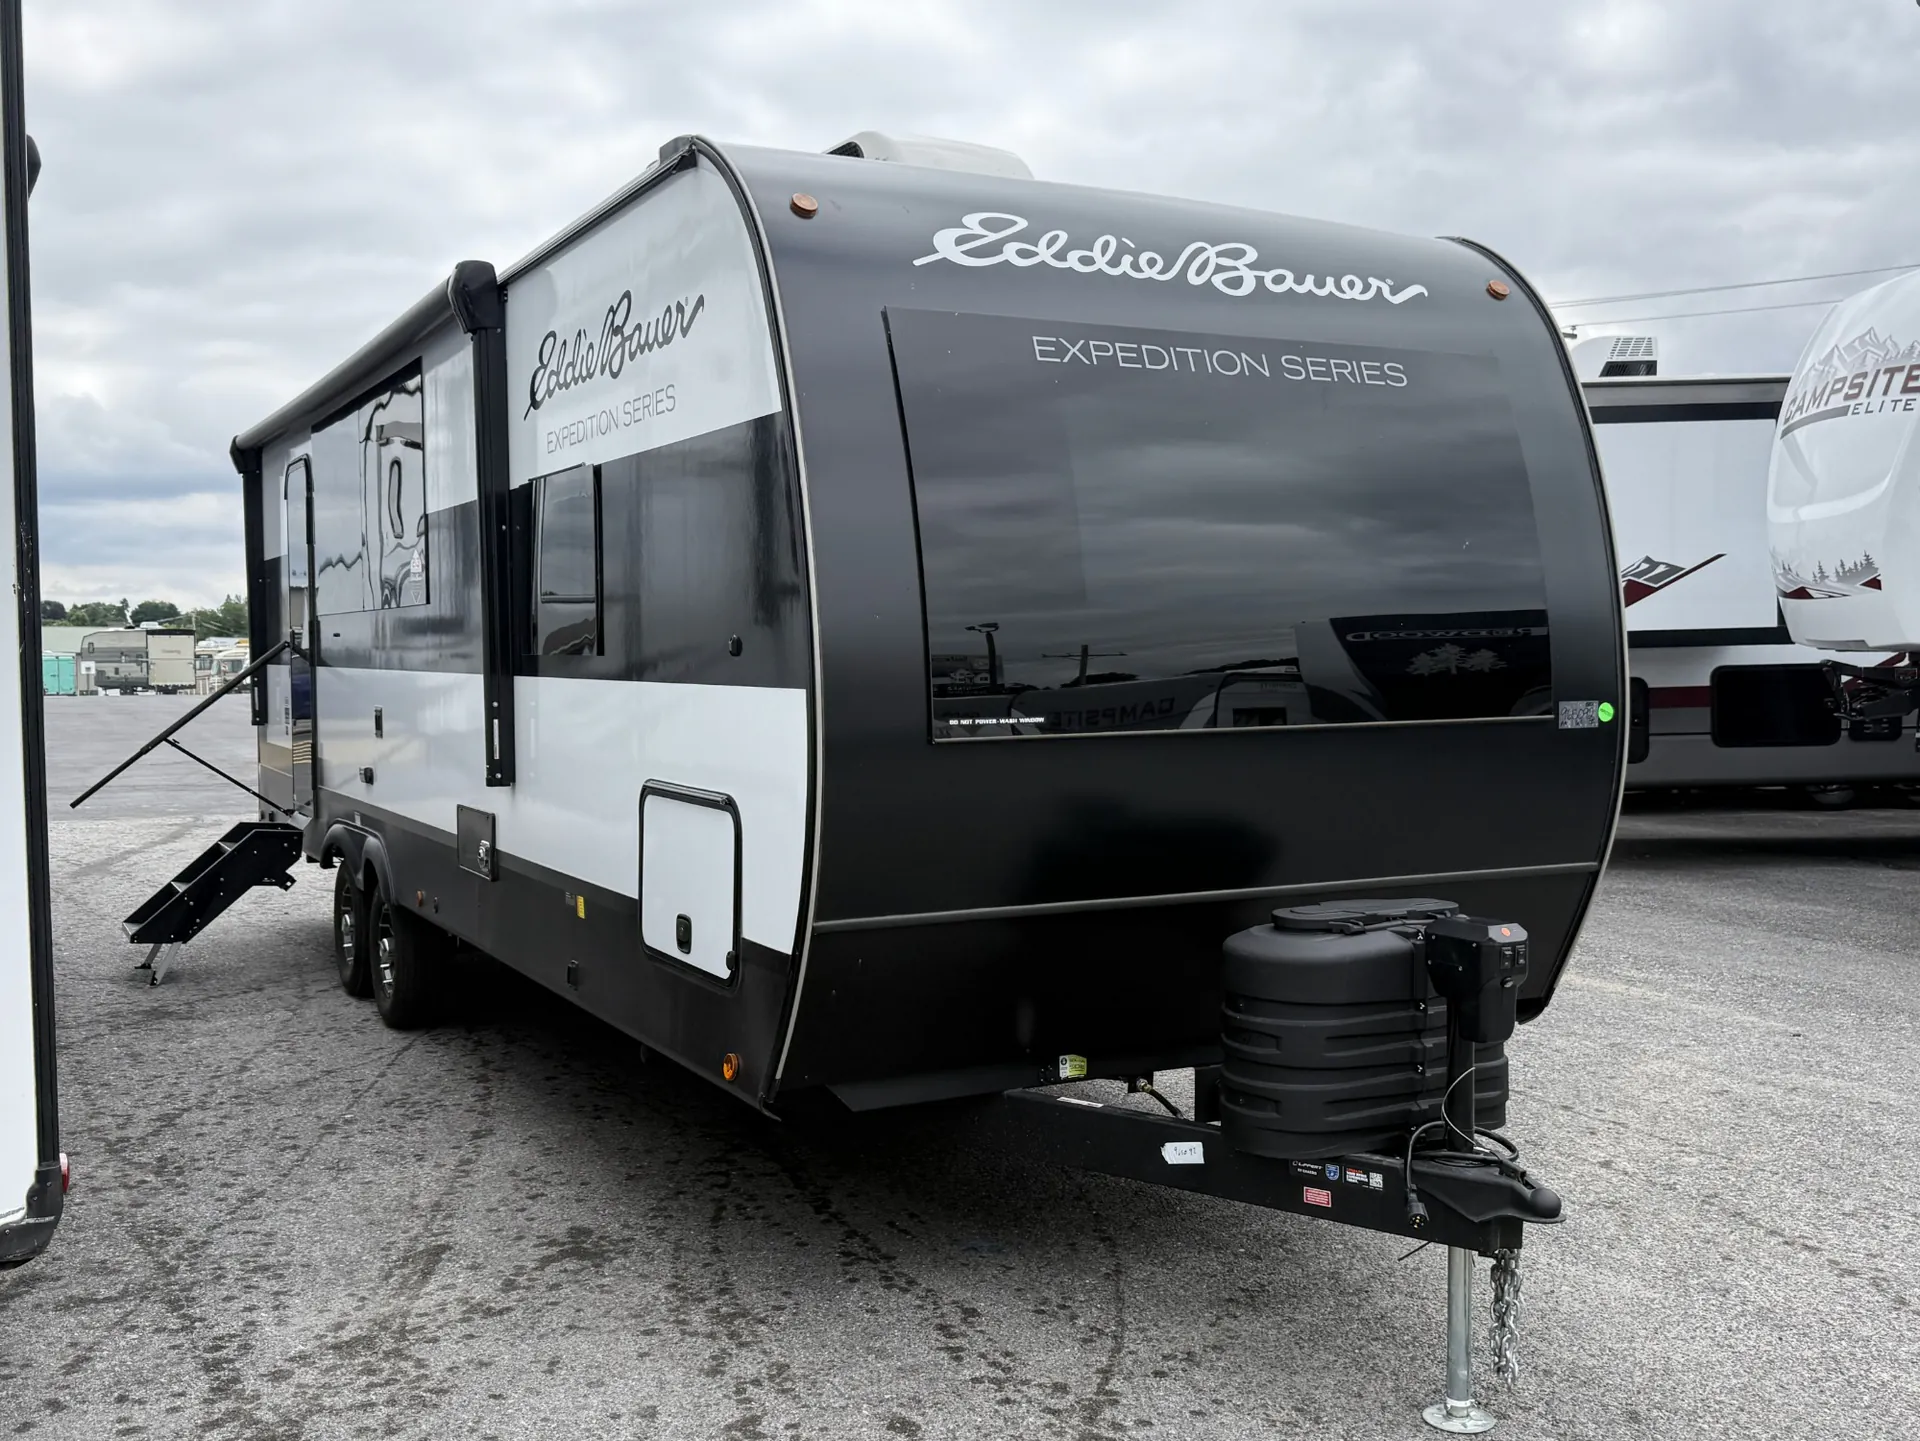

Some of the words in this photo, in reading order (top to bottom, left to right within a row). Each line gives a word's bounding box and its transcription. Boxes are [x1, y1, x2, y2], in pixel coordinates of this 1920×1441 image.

[912, 212, 1172, 280] Eddie
[1172, 241, 1429, 304] Bauer
[523, 330, 600, 421] Eddie
[599, 289, 705, 380] Bauer
[1032, 335, 1270, 378] EXPEDITION
[1281, 354, 1408, 387] SERIES
[546, 405, 619, 454] EXPEDITION
[622, 383, 676, 427] SERIES
[1783, 363, 1920, 426] CAMPSITE
[1851, 398, 1917, 416] ELITE
